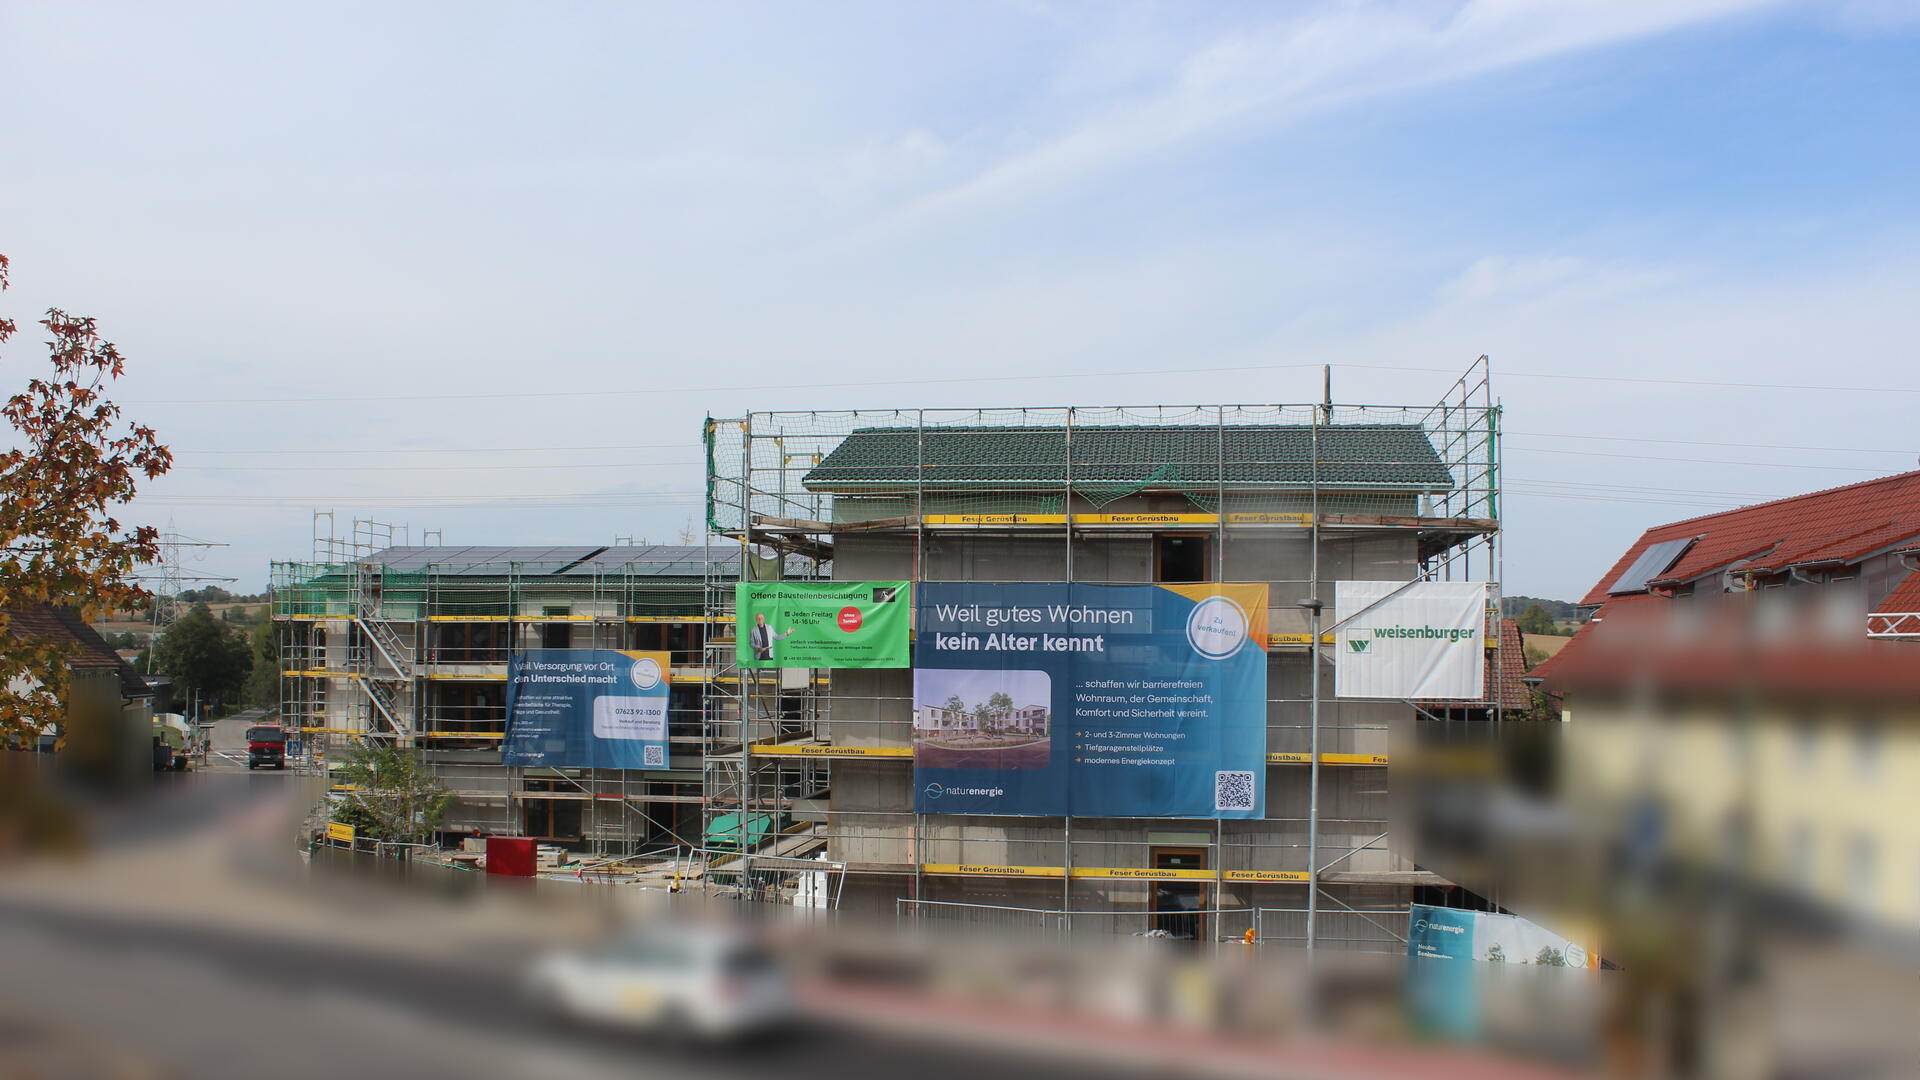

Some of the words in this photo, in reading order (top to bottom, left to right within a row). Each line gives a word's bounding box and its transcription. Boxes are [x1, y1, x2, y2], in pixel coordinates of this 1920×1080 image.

[750, 591, 777, 600] Offene
[778, 591, 868, 601] Baustellenbesichtigung
[935, 603, 981, 624] Weil
[986, 604, 1042, 626] gutes
[1047, 604, 1134, 624] Wohnen
[1213, 616, 1223, 624] Zu
[1197, 624, 1236, 637] verkaufen!
[1374, 625, 1475, 643] weisenburger
[935, 632, 980, 651] kein
[984, 632, 1038, 652] Alter
[1043, 633, 1104, 653] kennt
[533, 661, 583, 673] Versorgung
[583, 663, 597, 671] vor
[599, 662, 615, 671] Ort
[530, 674, 587, 684] Unterschied
[587, 675, 617, 684] macht
[1085, 680, 1125, 689] schaffen
[1126, 680, 1140, 689] wir
[1142, 680, 1203, 689] barrierefreien
[1075, 693, 1128, 704] Wohnraum,
[1129, 694, 1145, 703] der
[1146, 694, 1214, 705] Gemeinschaft,
[1075, 708, 1111, 717] Komfort
[1112, 708, 1130, 717] und
[1131, 708, 1175, 718] Sicherheit
[1177, 709, 1209, 718] vereint.
[1084, 730, 1092, 738] 2-
[1108, 731, 1142, 739] 3-Zimmer
[1143, 731, 1186, 741] Wohnungen
[824, 747, 865, 755] Gerüstbau
[1084, 743, 1164, 753] Tiefgaragenstellplätze
[1084, 757, 1120, 765] modernes
[1121, 757, 1175, 767] Energiekonzept
[946, 786, 1004, 798] naturenergie
[983, 866, 1025, 874] Gerüstbau
[1256, 872, 1300, 880] Gerüstbau
